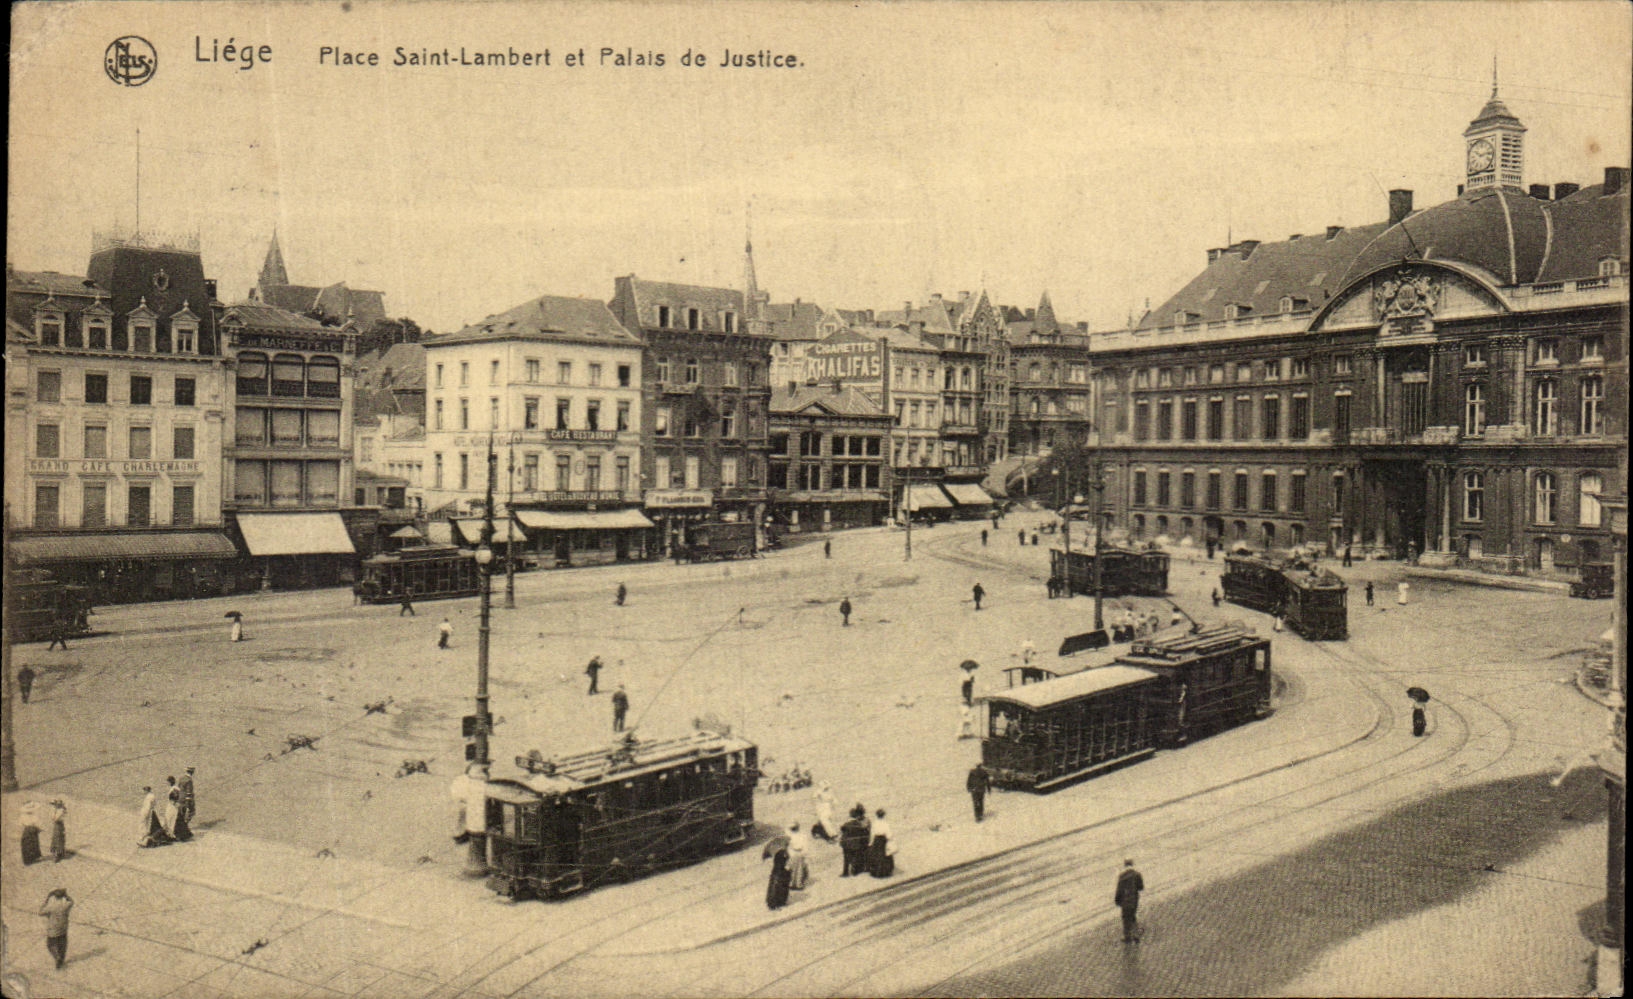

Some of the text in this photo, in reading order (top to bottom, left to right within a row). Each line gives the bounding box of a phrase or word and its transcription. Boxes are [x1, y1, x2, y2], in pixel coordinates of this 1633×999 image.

[807, 356, 881, 380] KHALIFAS
[30, 460, 69, 472] GRAND
[123, 461, 199, 472] CHARLEMAGNE
